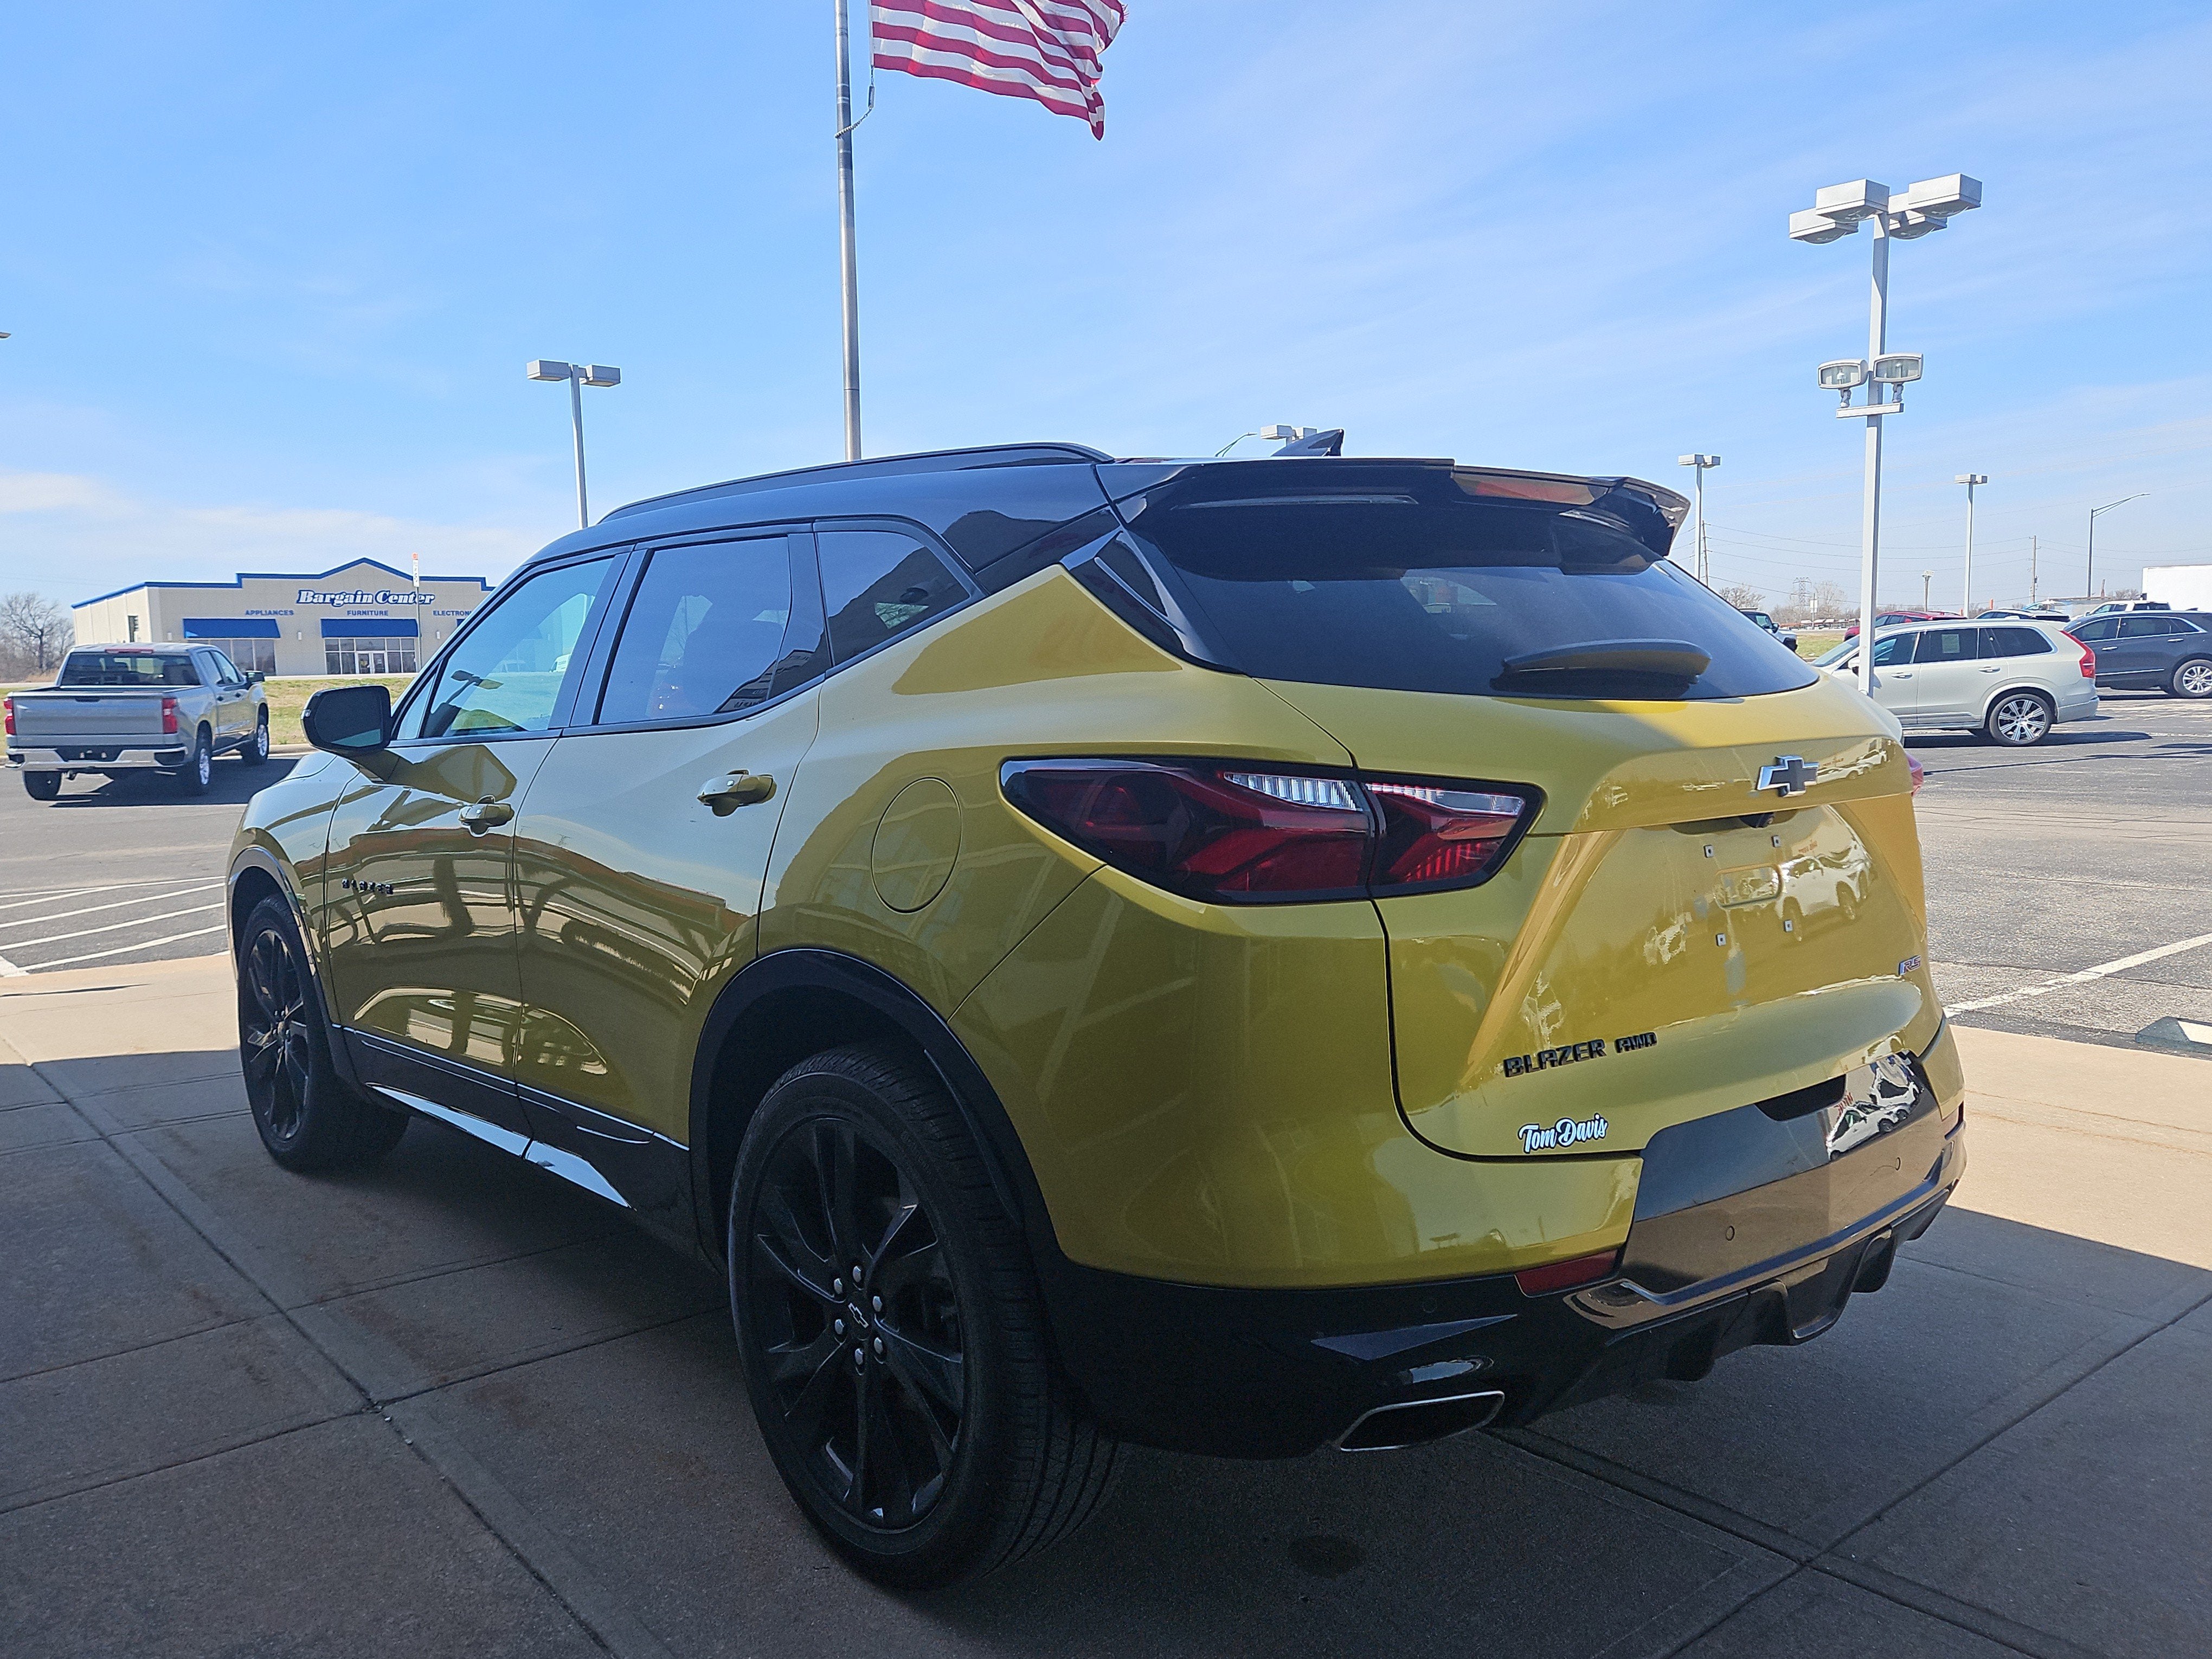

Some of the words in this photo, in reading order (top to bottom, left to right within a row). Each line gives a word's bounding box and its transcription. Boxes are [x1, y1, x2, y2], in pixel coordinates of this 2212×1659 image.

[296, 589, 374, 607] Bargain
[375, 590, 435, 605] Center
[1898, 955, 1921, 975] RS
[1503, 1039, 1607, 1078] BLAZER
[1614, 1032, 1657, 1053] AWD
[1518, 1124, 1557, 1154] Tom
[1555, 1113, 1609, 1148] Davis
